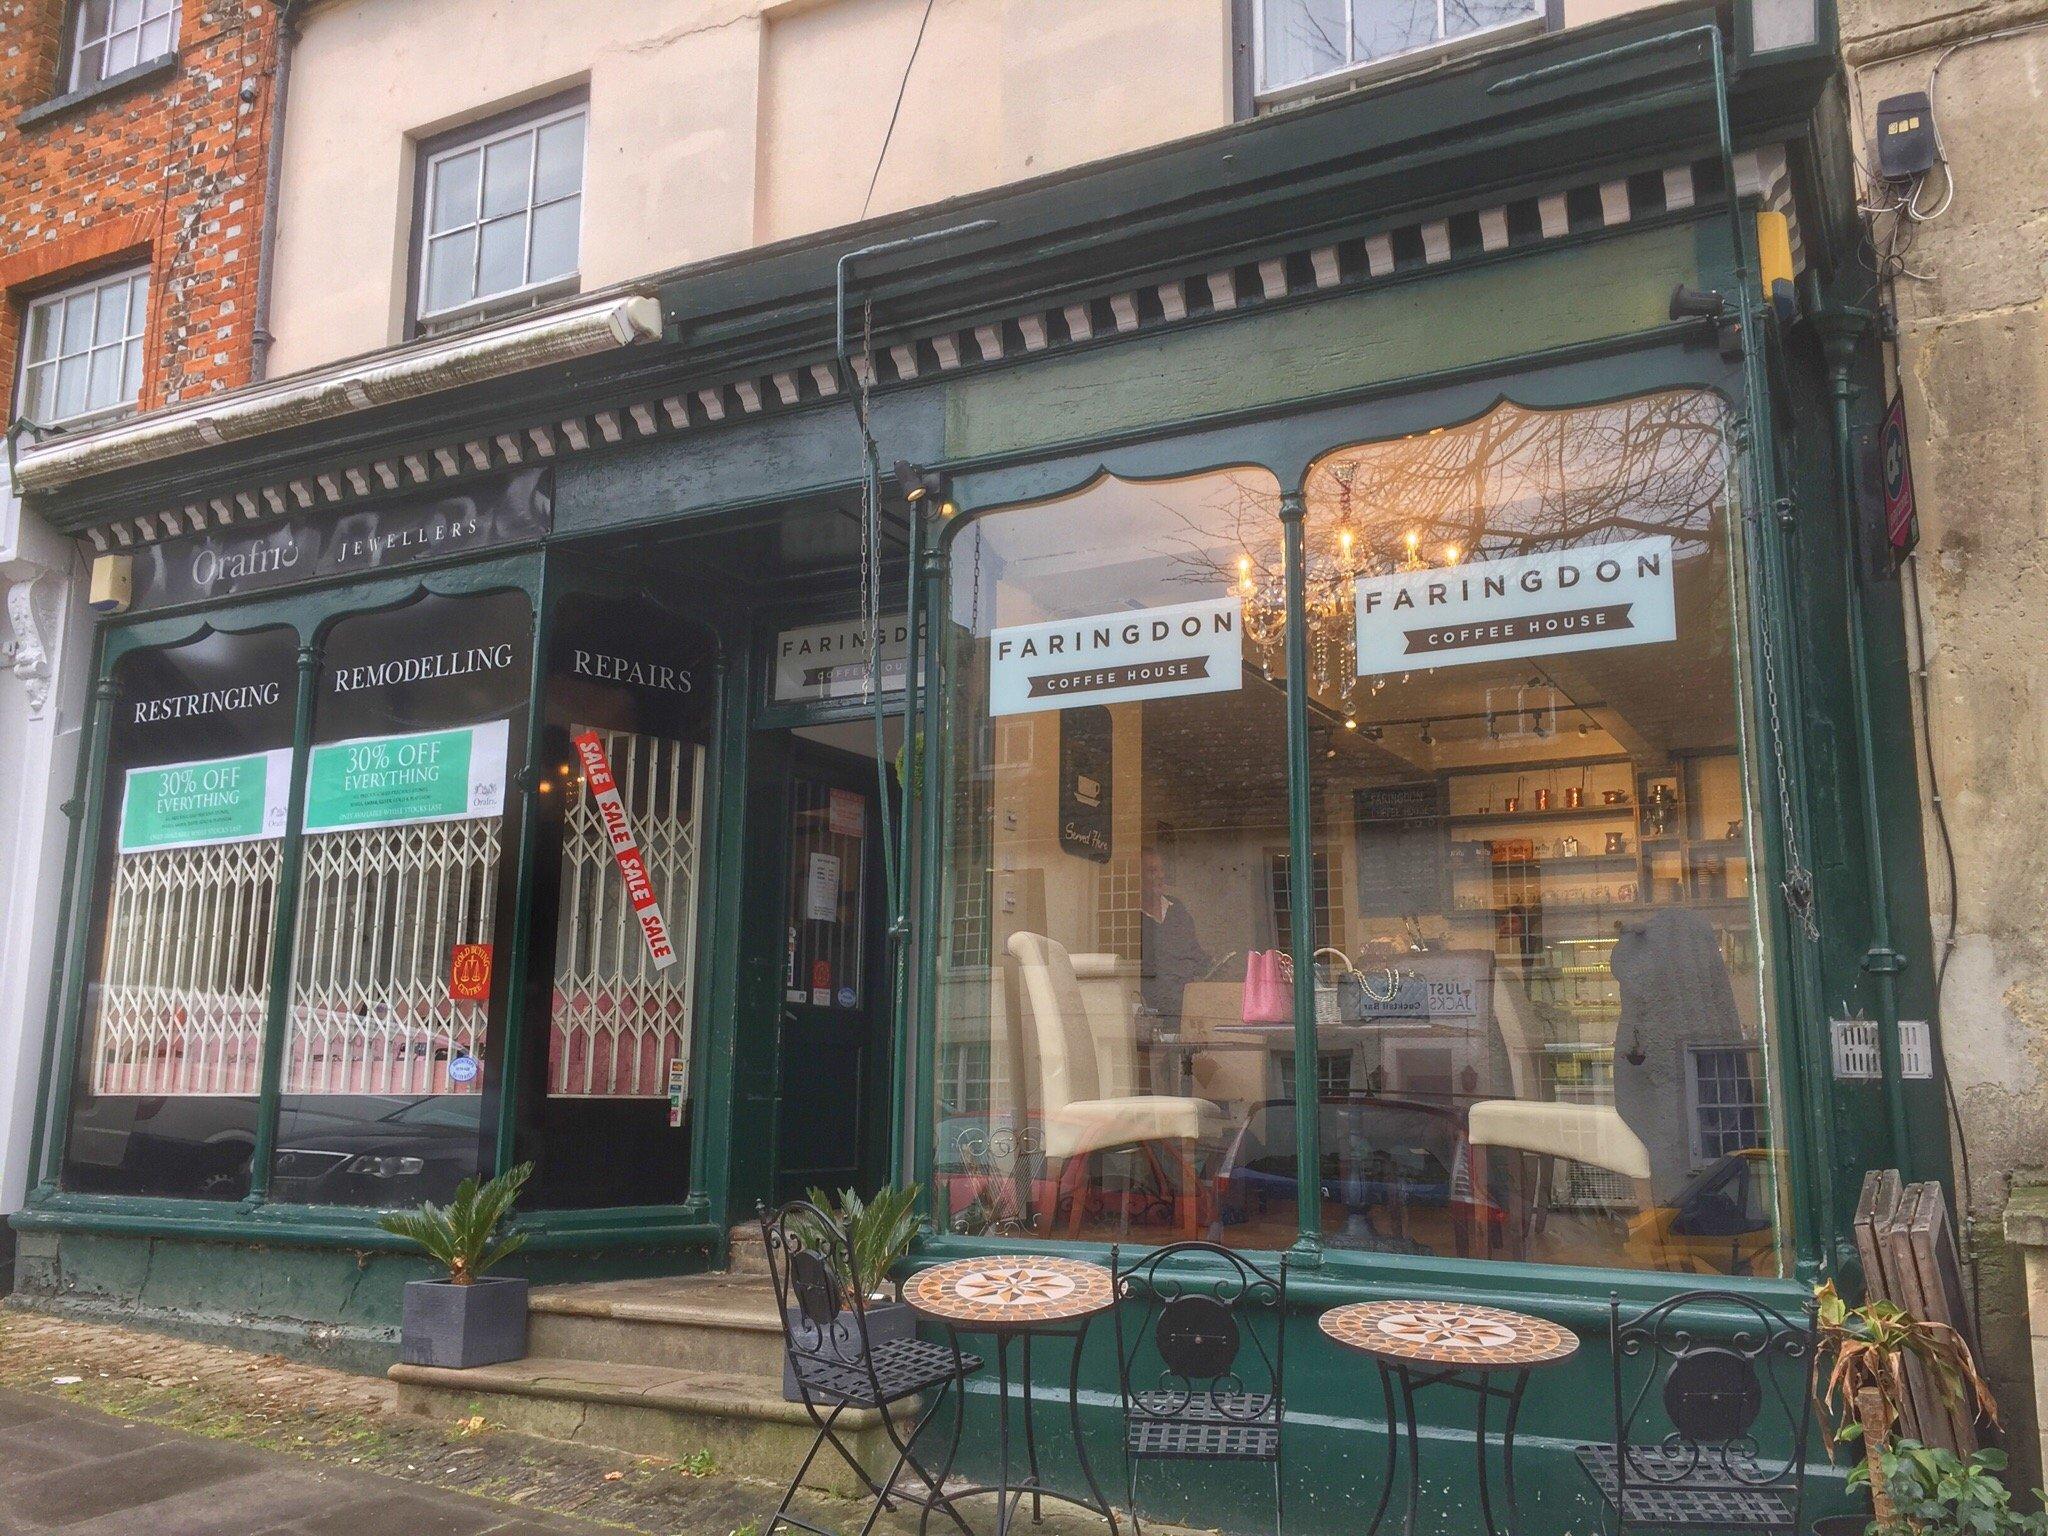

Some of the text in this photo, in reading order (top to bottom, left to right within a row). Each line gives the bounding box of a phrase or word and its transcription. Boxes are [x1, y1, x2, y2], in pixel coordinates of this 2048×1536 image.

[337, 518, 479, 563] JEWELLERS
[1365, 553, 1661, 614] FARINGDON
[998, 612, 1232, 661] FARINGDON
[1428, 613, 1607, 646] COFFEE HOUSE
[334, 643, 514, 693] REMODELLING
[573, 649, 693, 695] REPAIRS
[1047, 664, 1189, 690] COFFEE HOUSE
[133, 682, 280, 725] RESTRINGING
[346, 741, 442, 774] 30% OFF
[158, 766, 241, 798] 30% OFF
[344, 765, 440, 791] EVERYTHING
[157, 790, 240, 814] EVERYTHING
[1065, 822, 1091, 844] Served
[579, 741, 671, 959] SALE SALE SALE SALE
[454, 946, 471, 968] GOLD
